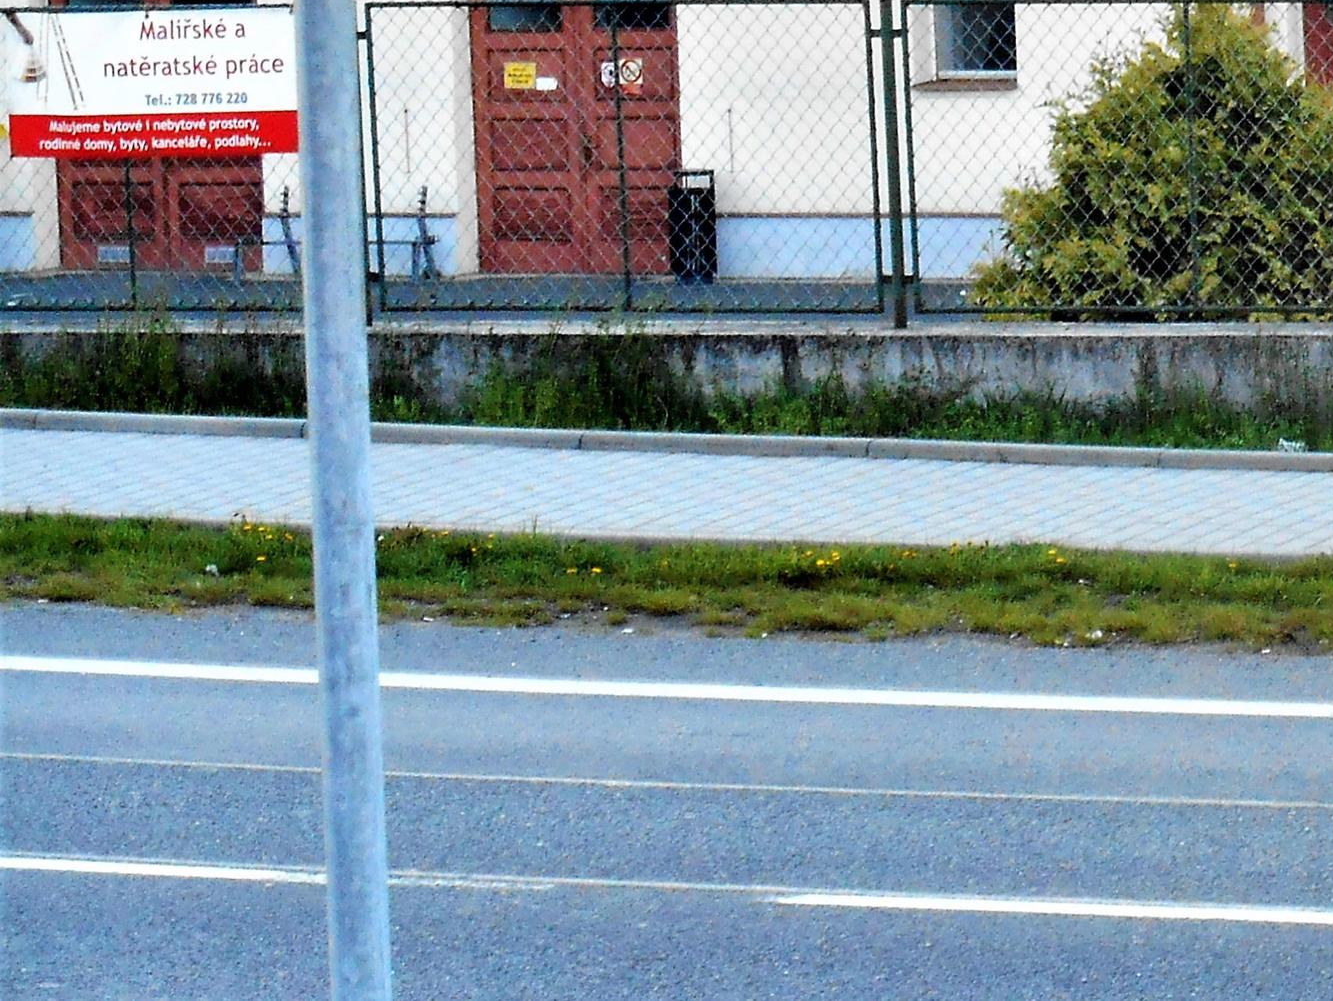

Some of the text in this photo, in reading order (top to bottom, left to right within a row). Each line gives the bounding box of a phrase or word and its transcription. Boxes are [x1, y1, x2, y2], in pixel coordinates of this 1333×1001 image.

[139, 18, 246, 40] Malířské a
[103, 53, 285, 80] natěratské práce
[145, 92, 249, 106] Tel.: 728 776 220
[49, 120, 100, 135] Malujeme
[103, 119, 143, 134] bytové
[153, 118, 207, 133] nebytové
[209, 118, 259, 133] prostory,
[39, 137, 81, 151] rodinné
[83, 137, 117, 152] domy,
[120, 137, 149, 151] byty,
[152, 135, 212, 150] kanceláře,
